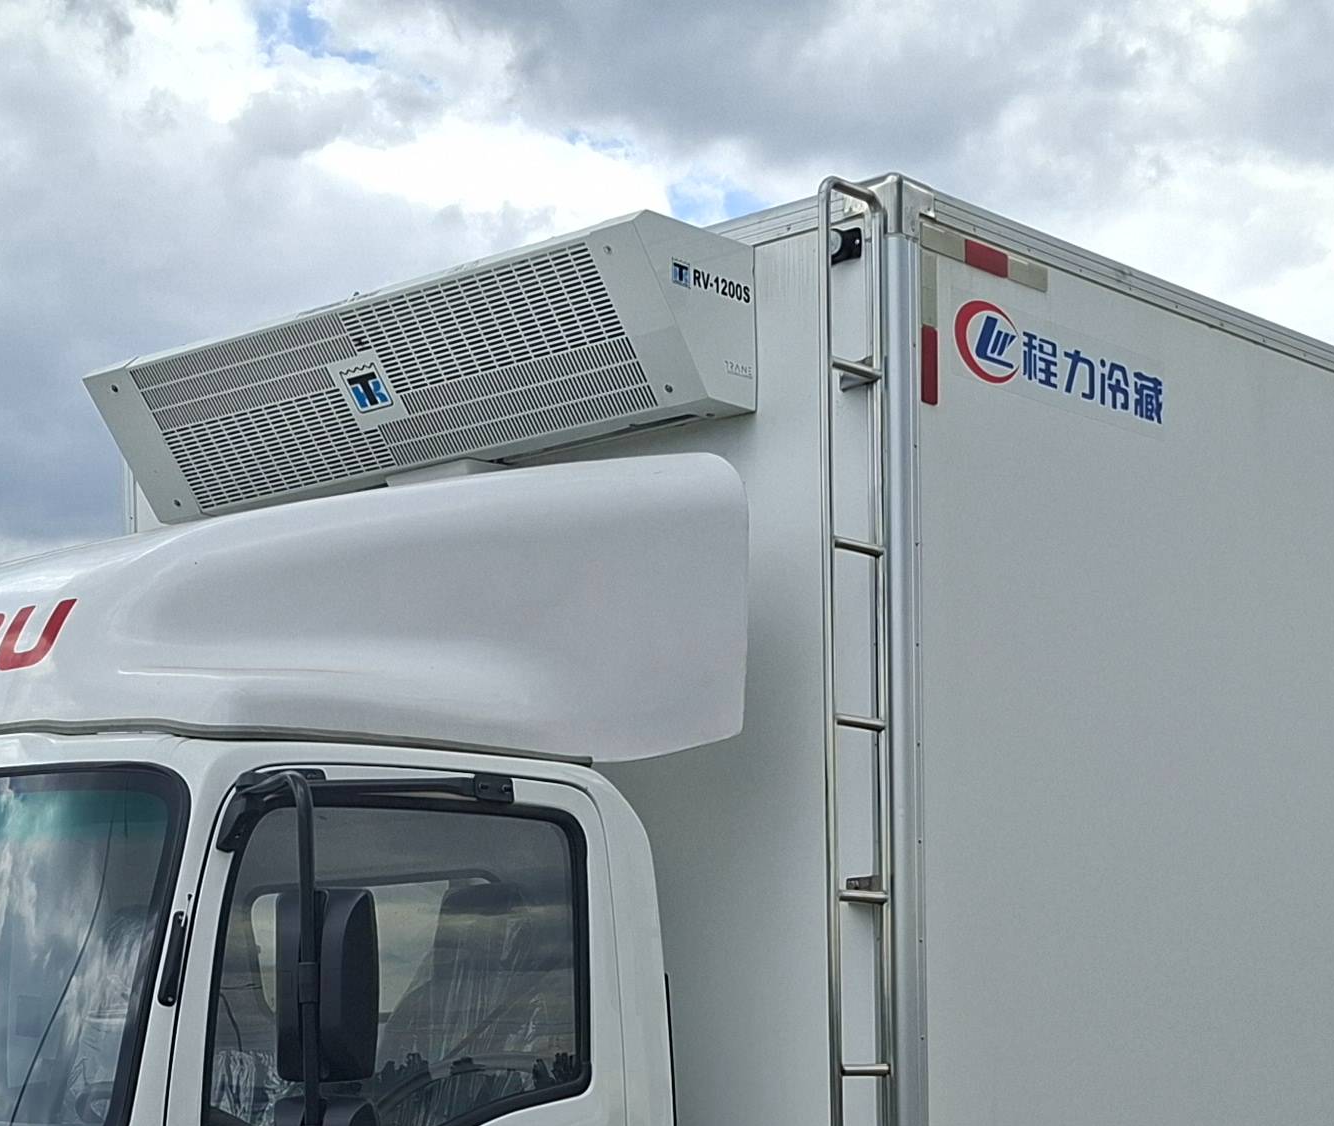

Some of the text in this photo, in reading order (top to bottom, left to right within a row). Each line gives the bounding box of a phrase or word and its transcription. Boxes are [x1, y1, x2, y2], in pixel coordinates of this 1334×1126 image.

[693, 269, 751, 304] RV-1200S
[1022, 331, 1163, 425] 程力冷藏
